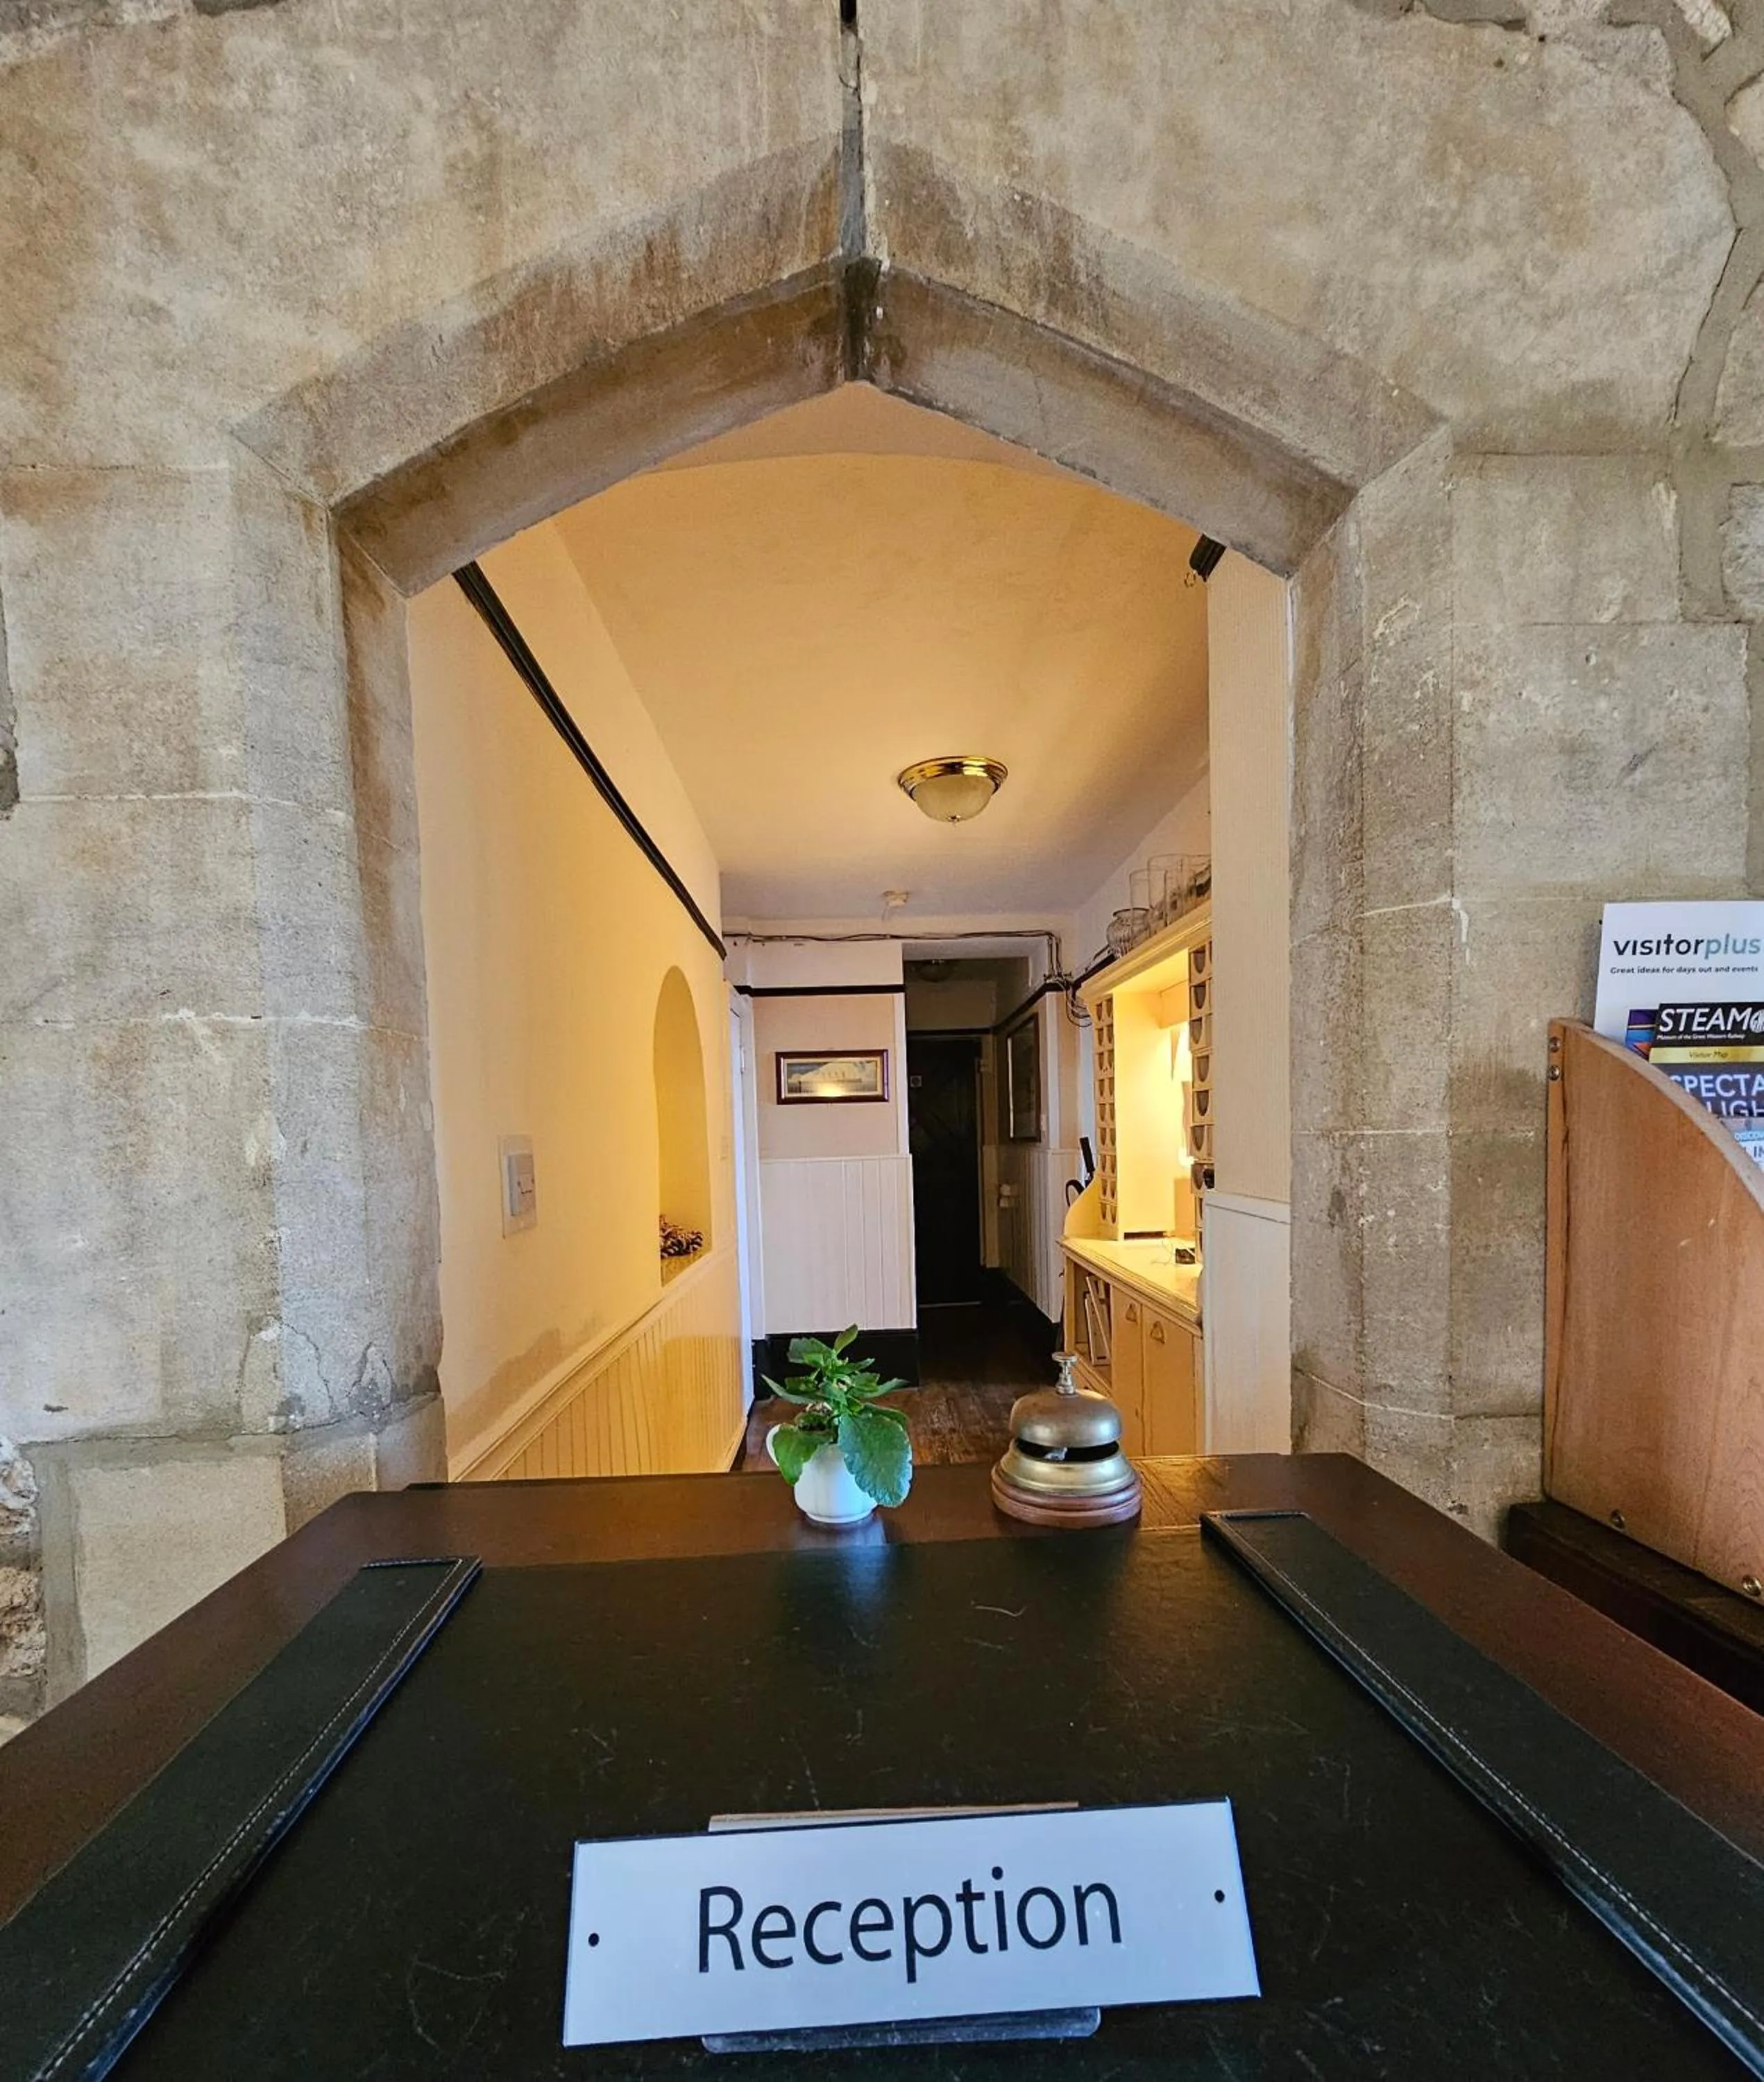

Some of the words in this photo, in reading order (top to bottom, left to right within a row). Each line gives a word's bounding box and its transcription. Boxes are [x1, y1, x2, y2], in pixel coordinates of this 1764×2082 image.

[1613, 932, 1761, 960] visitorplus
[1676, 965, 1695, 975] days
[1659, 1007, 1752, 1032] STEAM
[699, 1866, 1122, 1984] Reception
